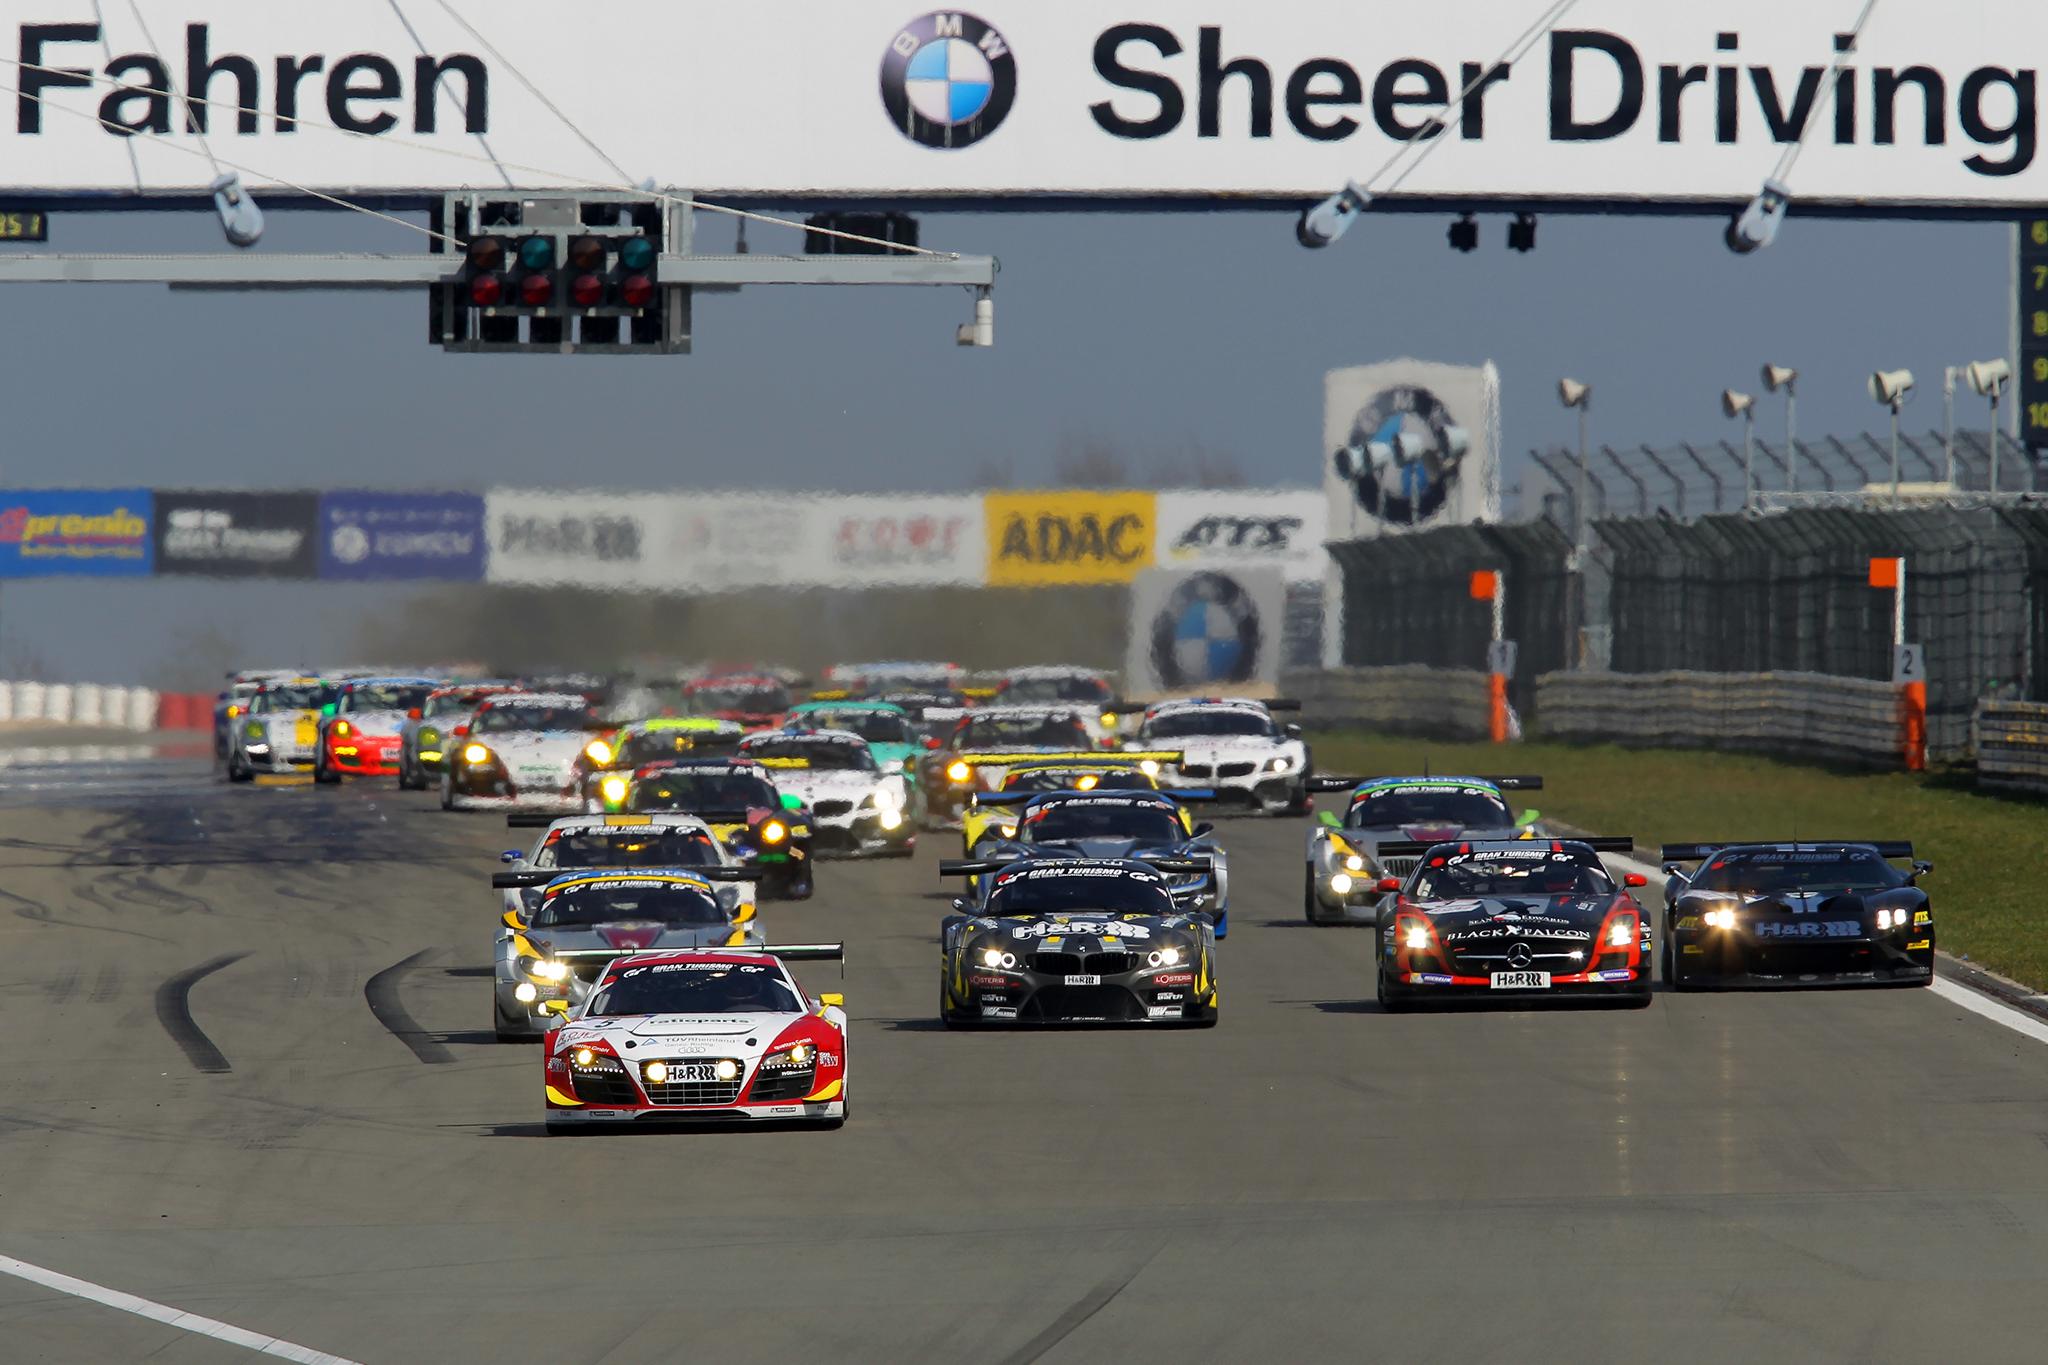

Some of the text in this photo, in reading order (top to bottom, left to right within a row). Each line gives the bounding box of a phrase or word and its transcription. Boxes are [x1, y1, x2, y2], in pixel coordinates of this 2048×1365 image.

[893, 14, 1009, 61] BMW
[17, 23, 488, 137] Fahren
[1087, 22, 2037, 177] Sheer Driving
[23, 507, 146, 541] premio
[999, 511, 1145, 563] ADAC
[1902, 649, 1913, 675] 2
[1474, 852, 1501, 860] GRAN
[1752, 854, 1785, 862] GRAN
[1789, 853, 1840, 861] TURISMO
[1029, 869, 1063, 877] GRAN
[1067, 868, 1124, 876] TURISMO
[1522, 915, 1570, 924] EDWARDS
[1447, 928, 1590, 941] BLACK FALCON
